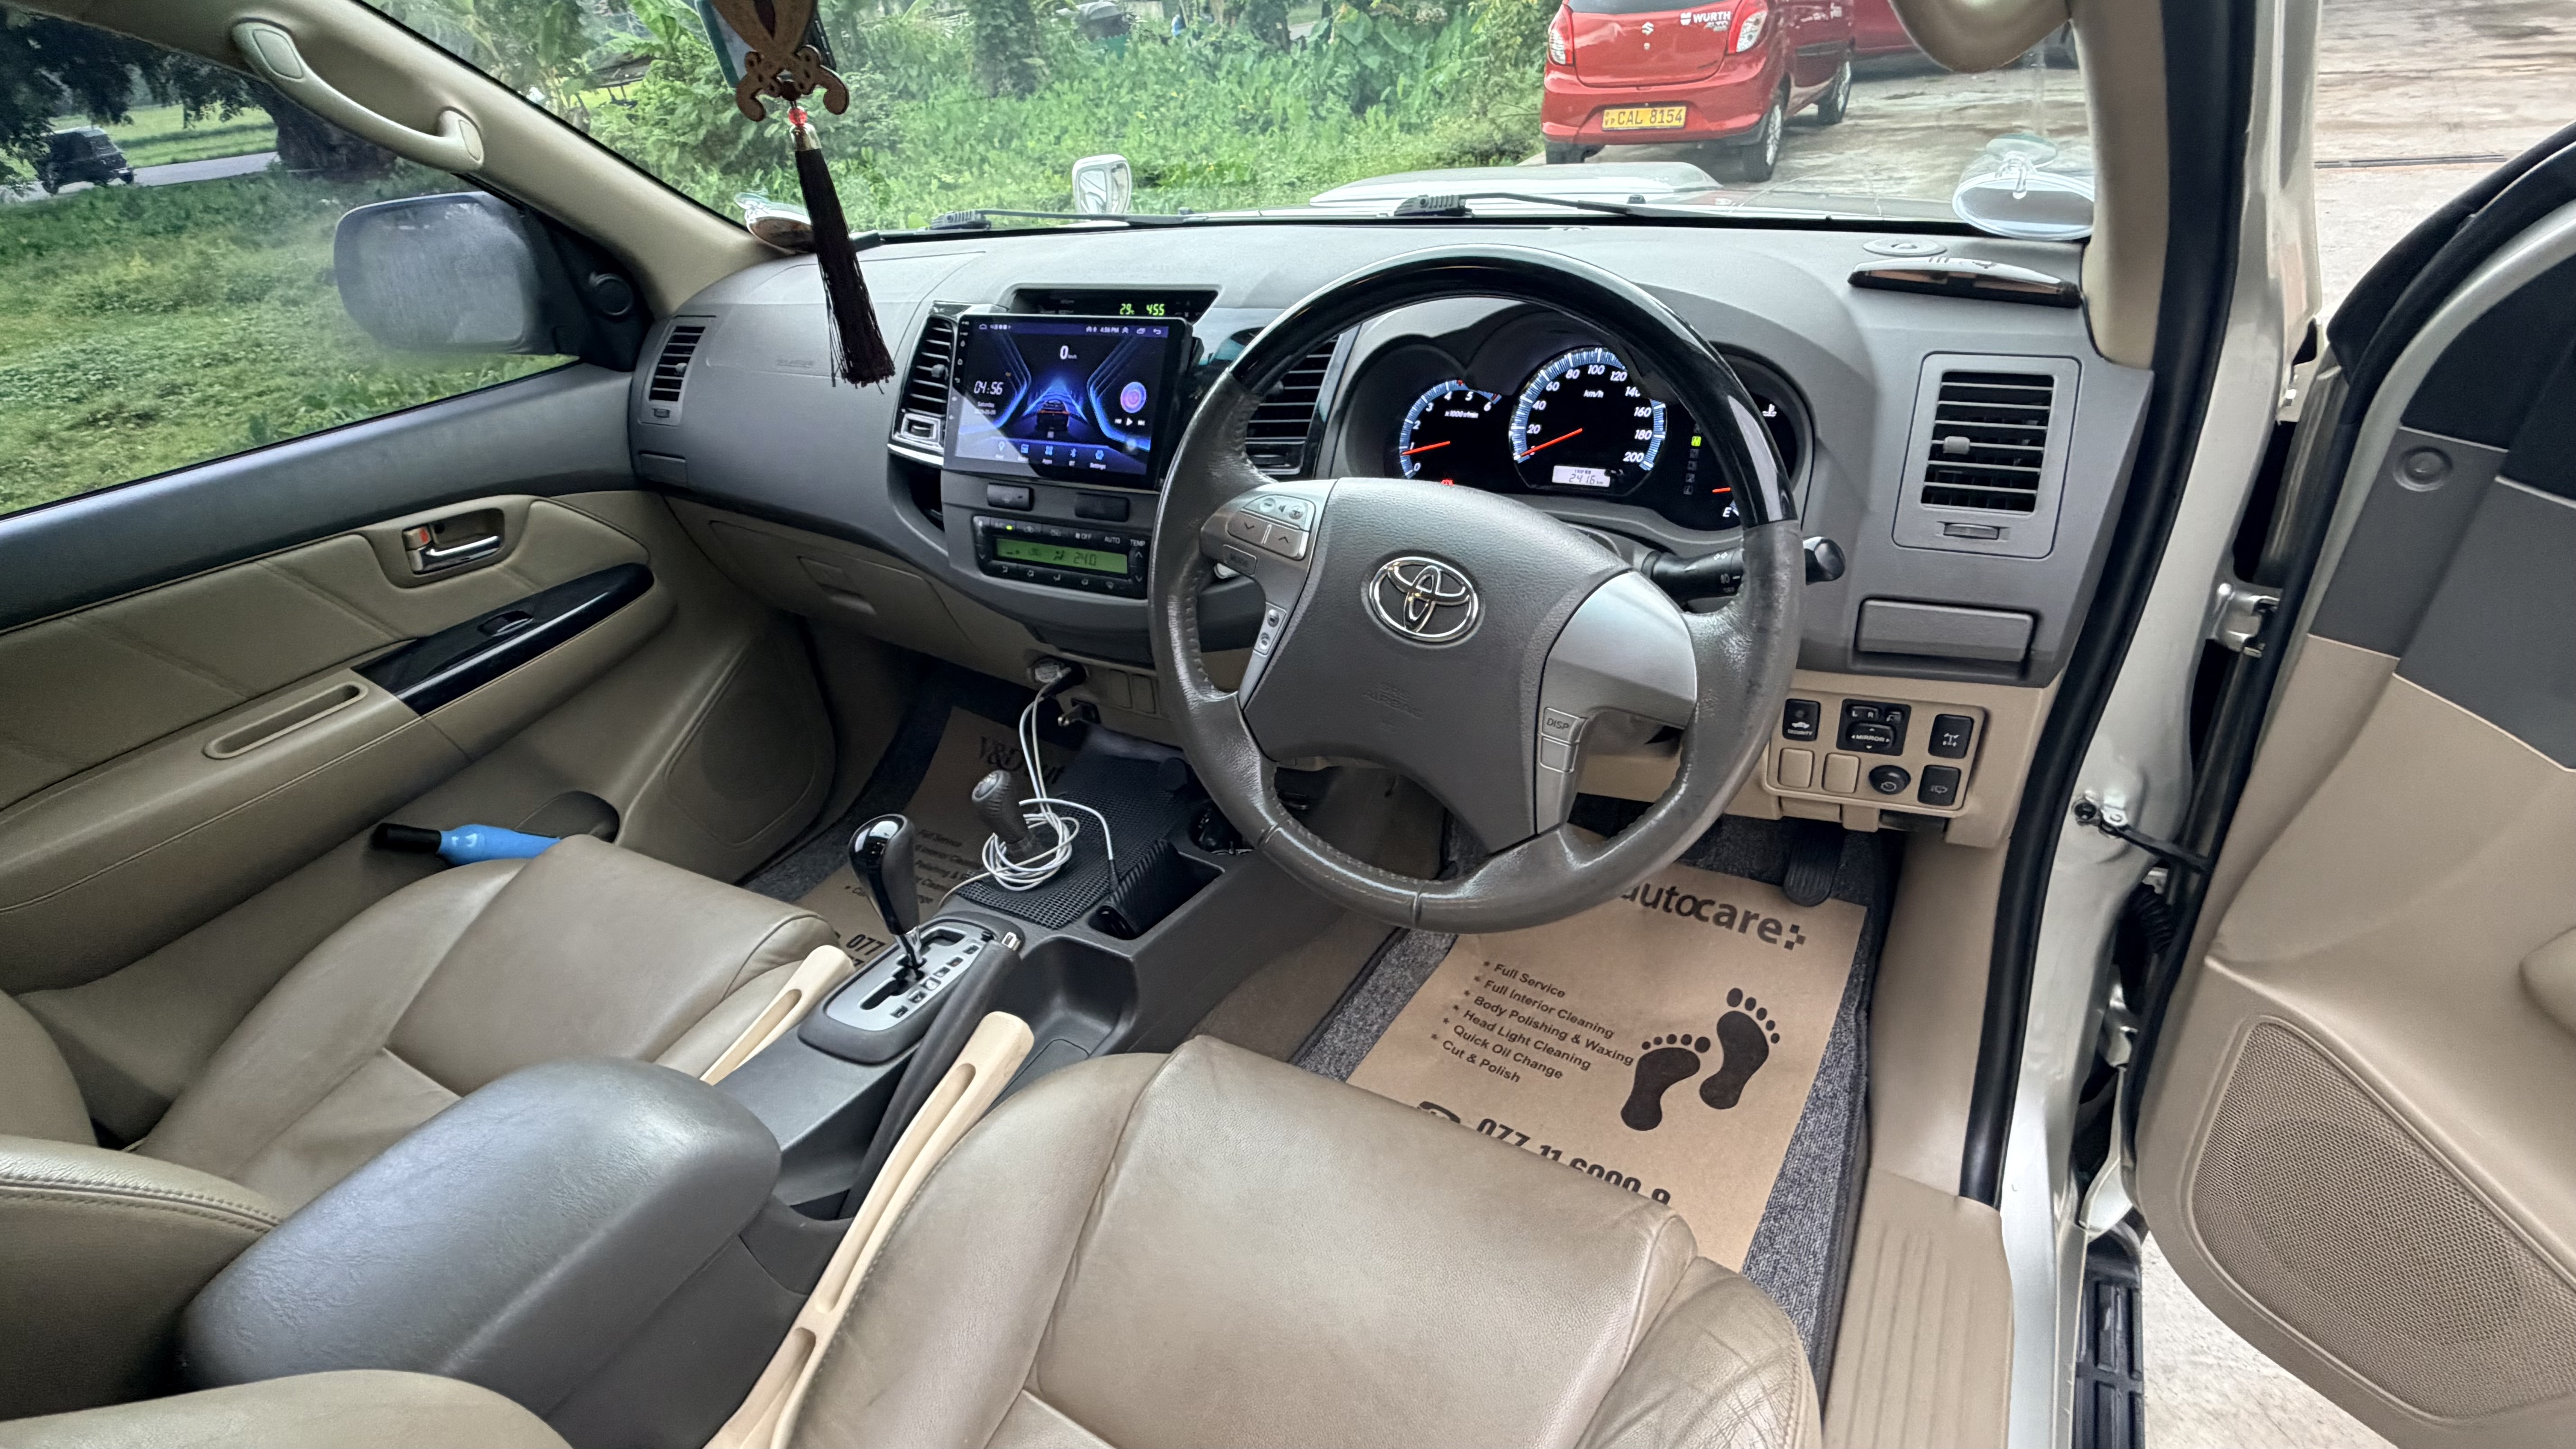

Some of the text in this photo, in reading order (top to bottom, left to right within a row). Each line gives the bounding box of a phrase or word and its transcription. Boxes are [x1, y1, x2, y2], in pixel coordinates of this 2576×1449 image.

[1617, 111, 1643, 125] CAL
[1650, 109, 1683, 124] 8154
[1566, 369, 1580, 379] 80
[1587, 365, 1605, 375] 100
[1610, 371, 1627, 381] 120
[974, 381, 1004, 395] 04:56
[1546, 382, 1560, 391] 60
[1444, 391, 1452, 400] 4
[1465, 391, 1473, 401] 5
[1583, 390, 1604, 398] km/h
[1426, 402, 1434, 412] 3
[1483, 401, 1491, 411] 6
[1532, 400, 1547, 410] 40
[1634, 407, 1651, 417] 160
[1412, 420, 1421, 429] 2
[1527, 424, 1541, 434] 20
[1634, 429, 1652, 440] 180
[1623, 451, 1644, 462] 200
[1414, 463, 1421, 471] 0
[1722, 507, 1732, 517] E
[1547, 718, 1569, 730] DISP
[846, 934, 887, 956] 077
[1494, 963, 1566, 998] Full Service
[1484, 980, 1615, 1040] Full Interior Cleaning
[1474, 995, 1635, 1067] Body Polishing & Waxing
[1463, 1010, 1592, 1071] Head Light Cleaning
[1454, 1025, 1563, 1080] Quick Oil Change
[1443, 1040, 1521, 1083] Cut & Polish
